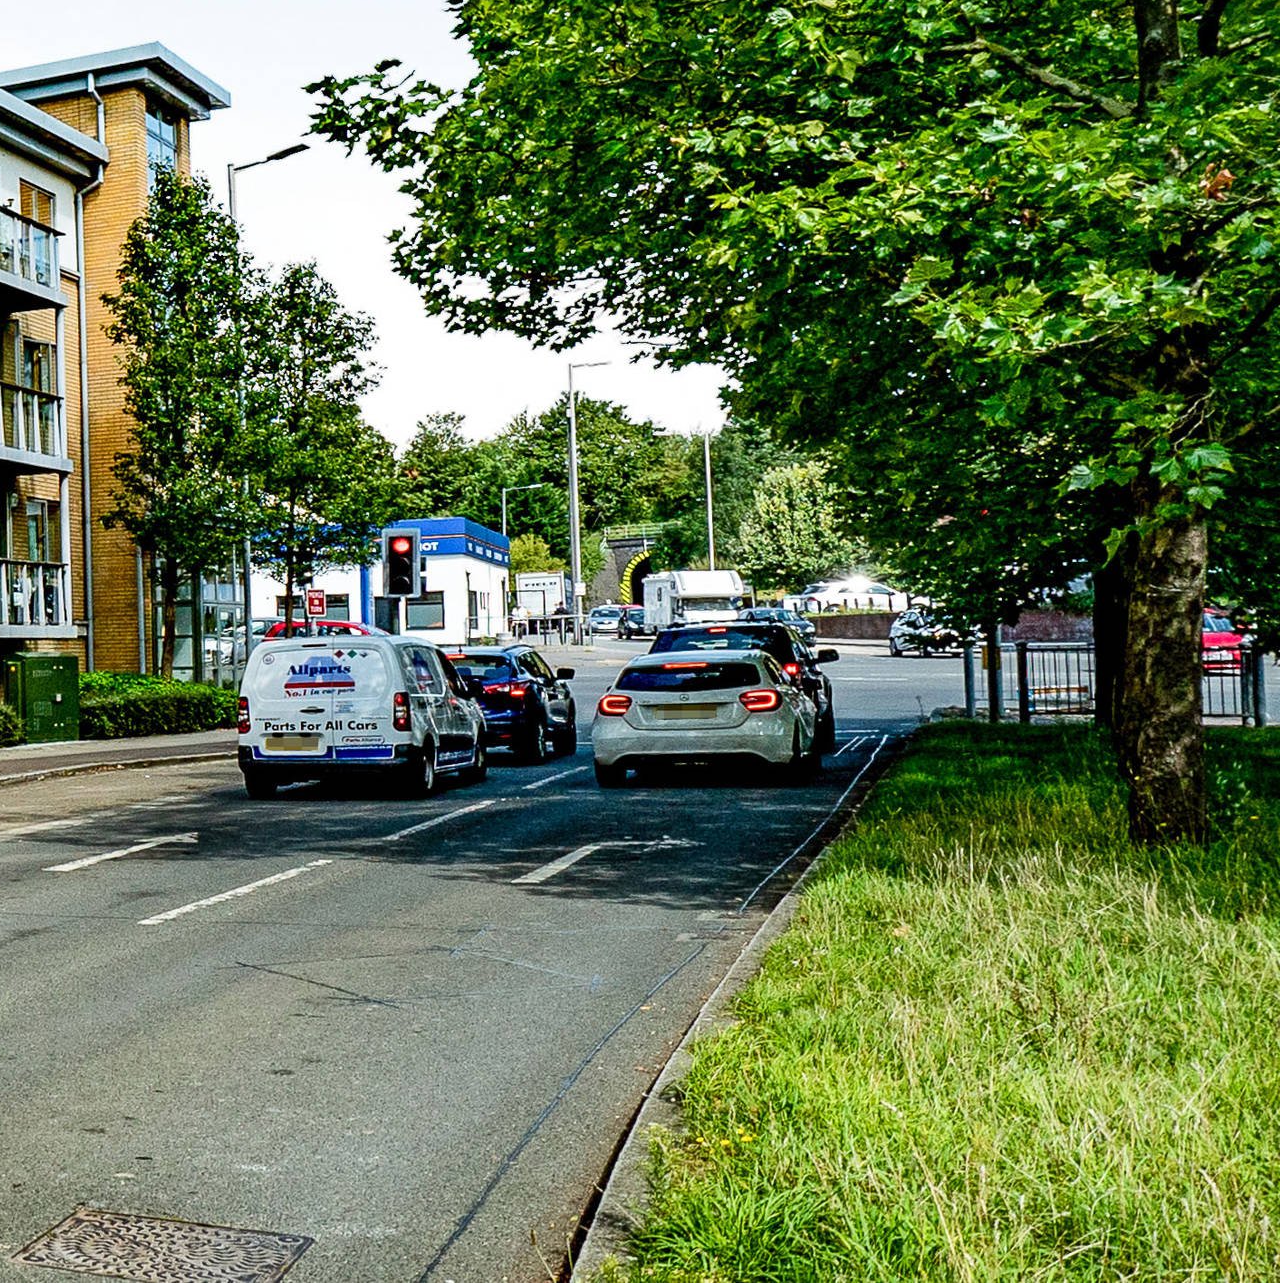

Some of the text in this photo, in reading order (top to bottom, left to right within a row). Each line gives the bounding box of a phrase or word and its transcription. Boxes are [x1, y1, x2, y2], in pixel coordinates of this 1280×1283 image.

[287, 664, 351, 677] Allparts
[284, 689, 307, 698] No.1
[264, 720, 378, 731] Parts For All Cars
